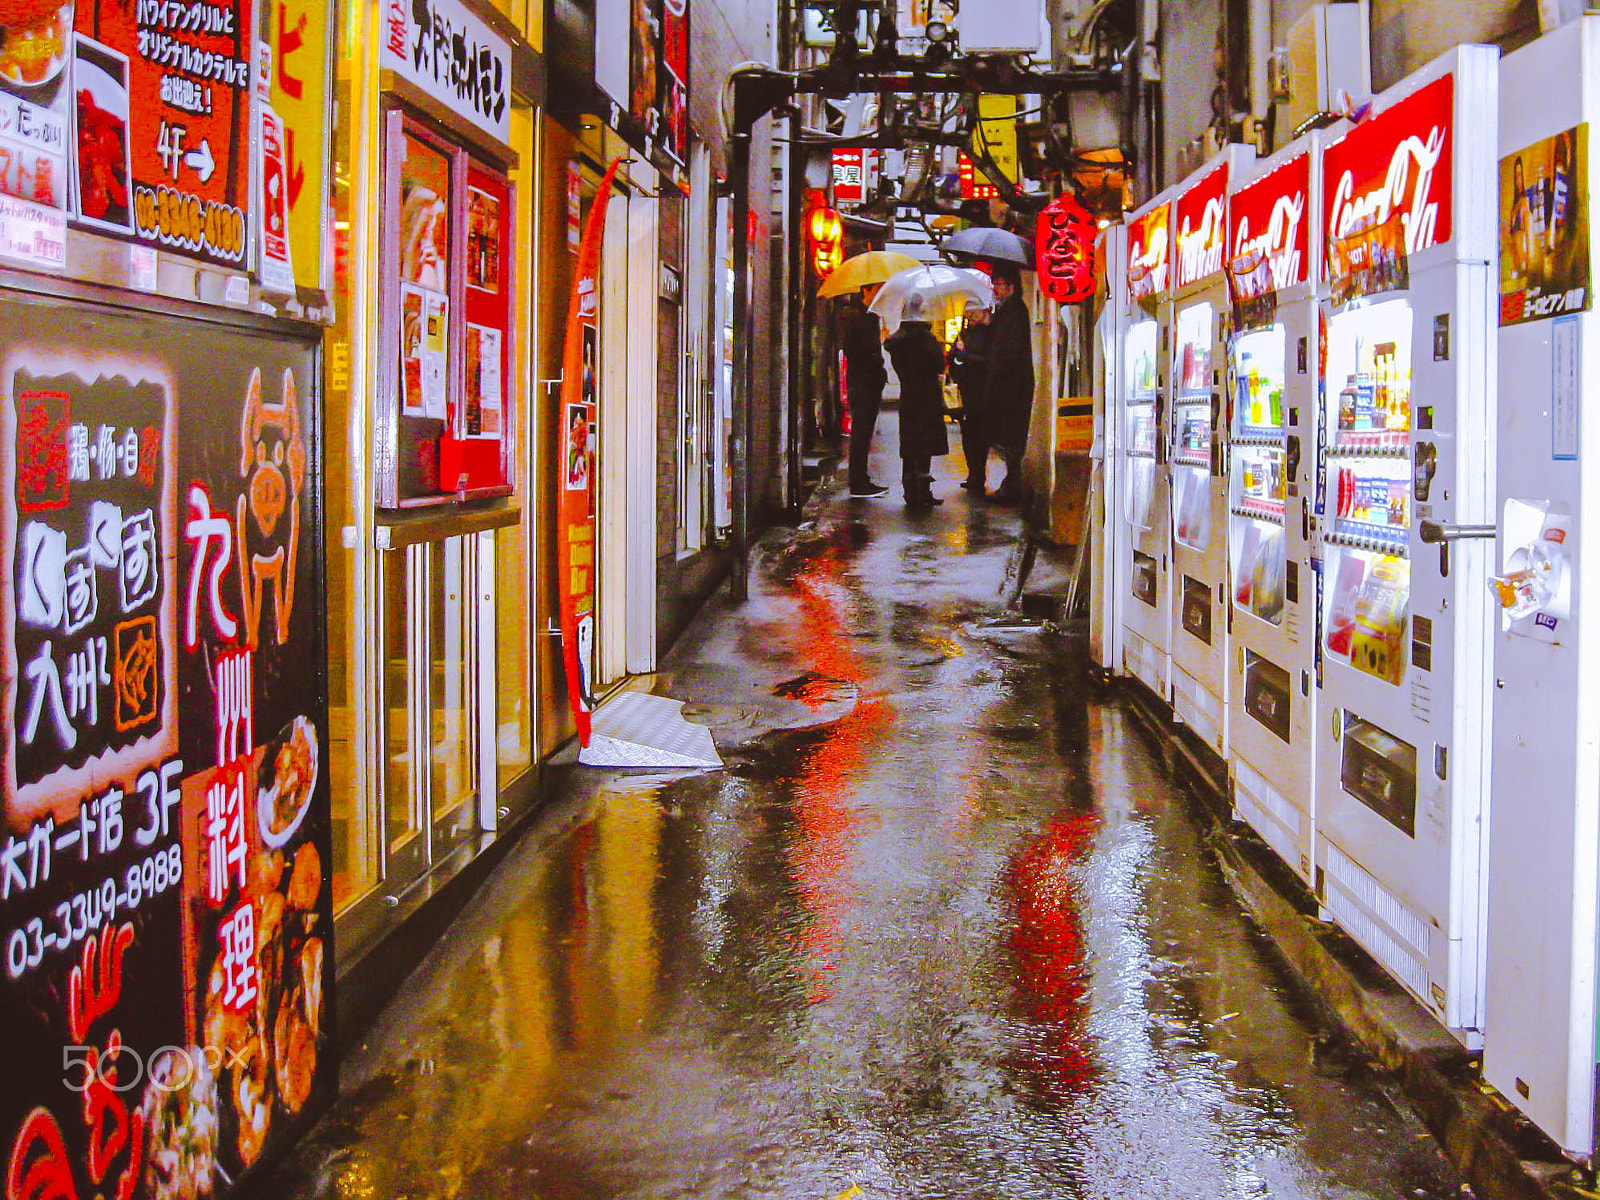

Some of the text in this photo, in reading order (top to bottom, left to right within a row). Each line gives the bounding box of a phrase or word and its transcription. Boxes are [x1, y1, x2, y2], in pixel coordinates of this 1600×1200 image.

[137, 29, 247, 87] オリジナルカクテルで
[157, 121, 187, 179] 4F
[186, 485, 257, 1010] 九州料理
[136, 759, 183, 846] 3F
[8, 844, 182, 979] 03-3349-8988
